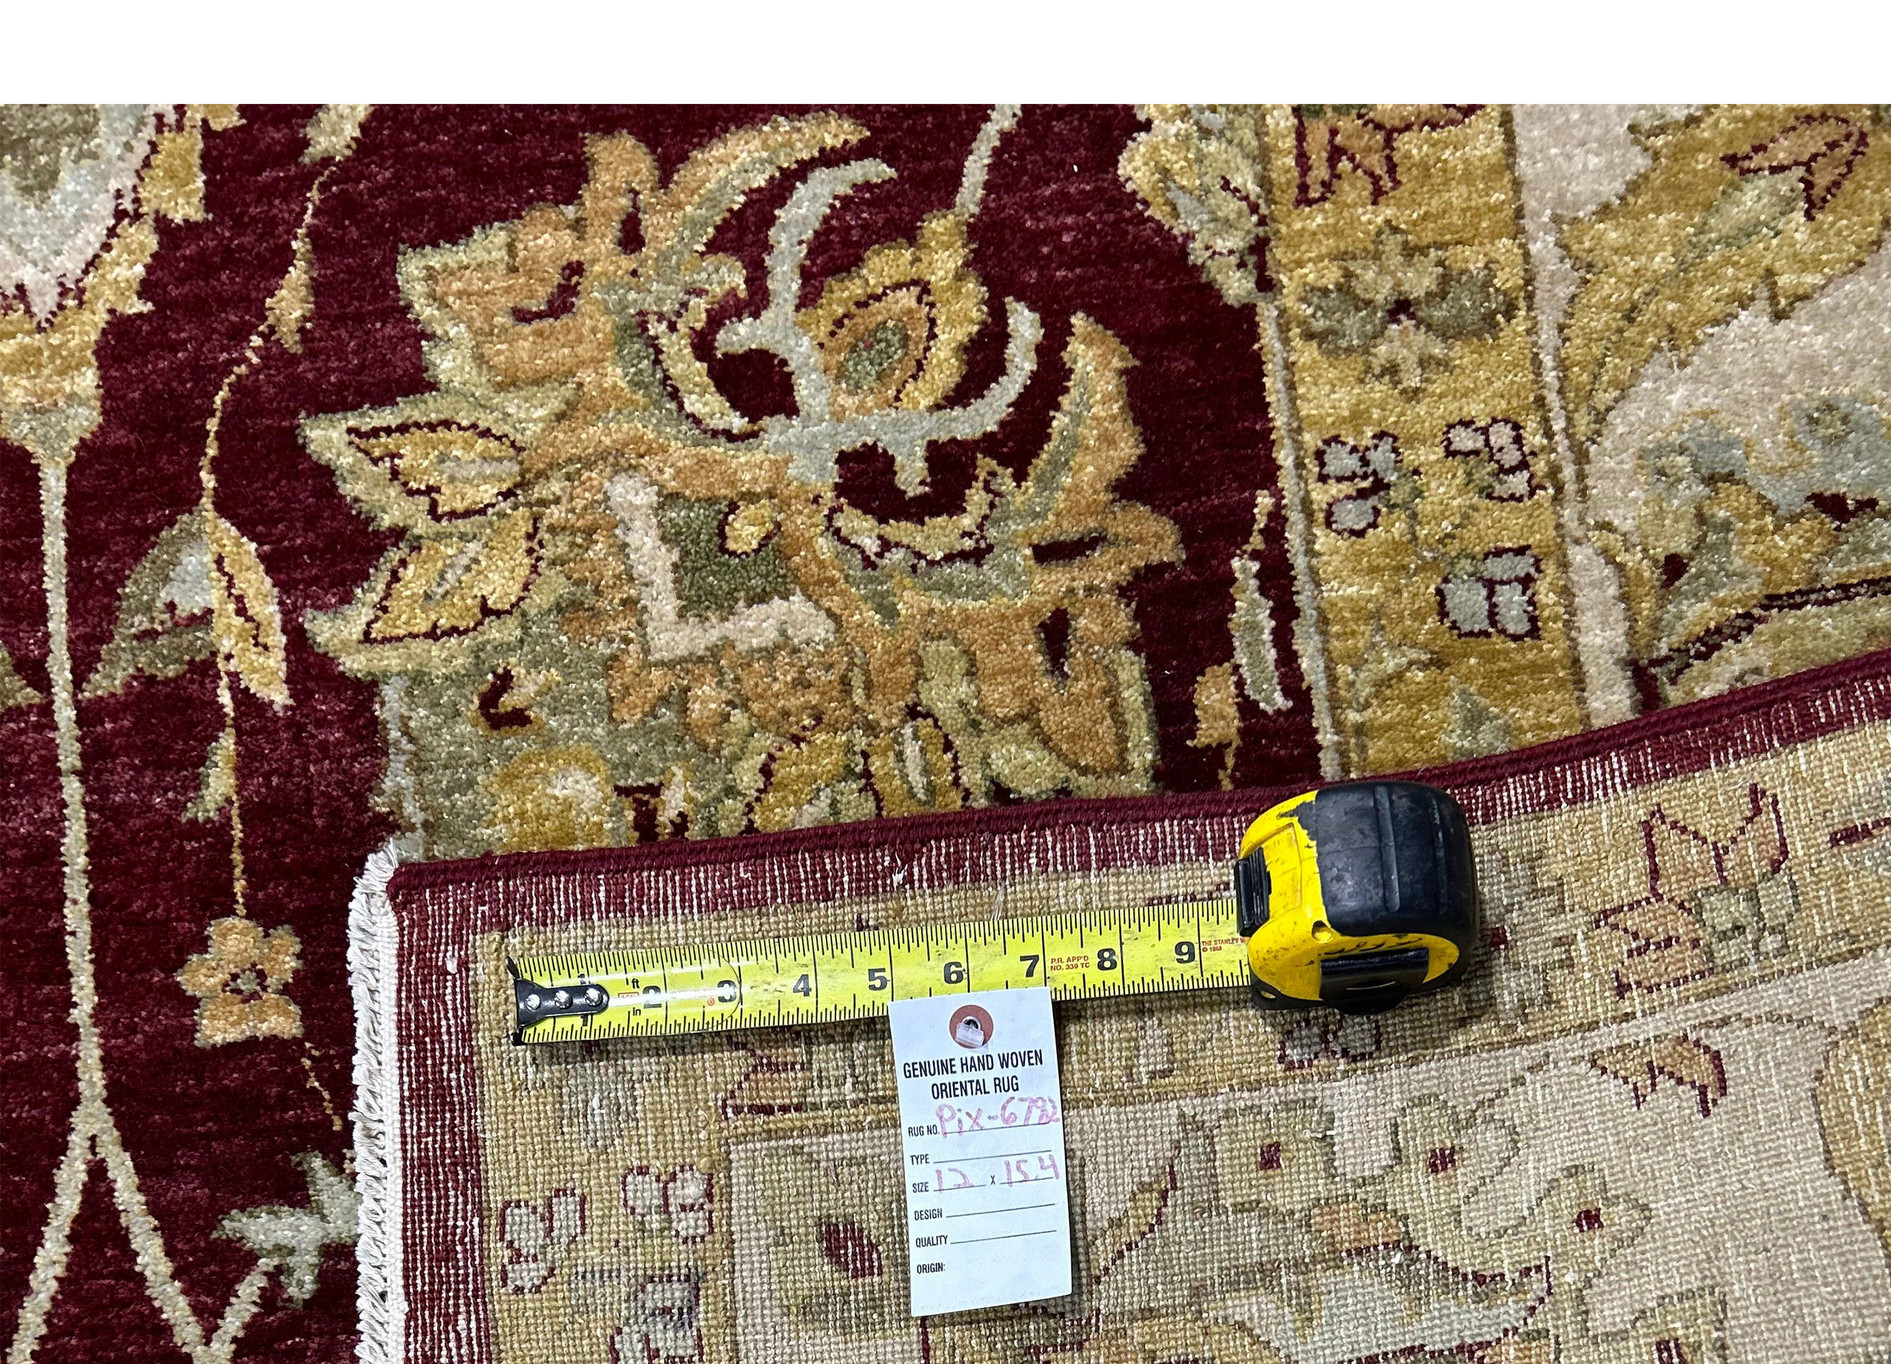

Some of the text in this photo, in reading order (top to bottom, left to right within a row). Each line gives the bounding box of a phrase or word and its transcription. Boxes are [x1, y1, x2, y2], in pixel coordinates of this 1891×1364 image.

[642, 985, 662, 1009] 2
[717, 979, 737, 1003] 3
[792, 973, 812, 997] 4
[867, 967, 888, 991] 5
[943, 961, 964, 984] 6
[1019, 954, 1040, 978] 7
[1096, 947, 1118, 971] 8
[1174, 941, 1196, 964] 9
[631, 978, 640, 989] ft
[632, 1007, 641, 1016] in
[903, 1049, 1044, 1079] GENUINE HAND WOVEN
[931, 1075, 1020, 1100] ORIENTAL RUG
[908, 1125, 925, 1137] RUG
[926, 1124, 940, 1136] NO.
[910, 1153, 930, 1166] TYPE
[912, 1181, 930, 1193] SIZE
[935, 1167, 975, 1194] 12
[914, 1207, 943, 1221] DESIGN
[915, 1234, 949, 1248] QUALITY
[916, 1262, 947, 1275] ORIGIN:
